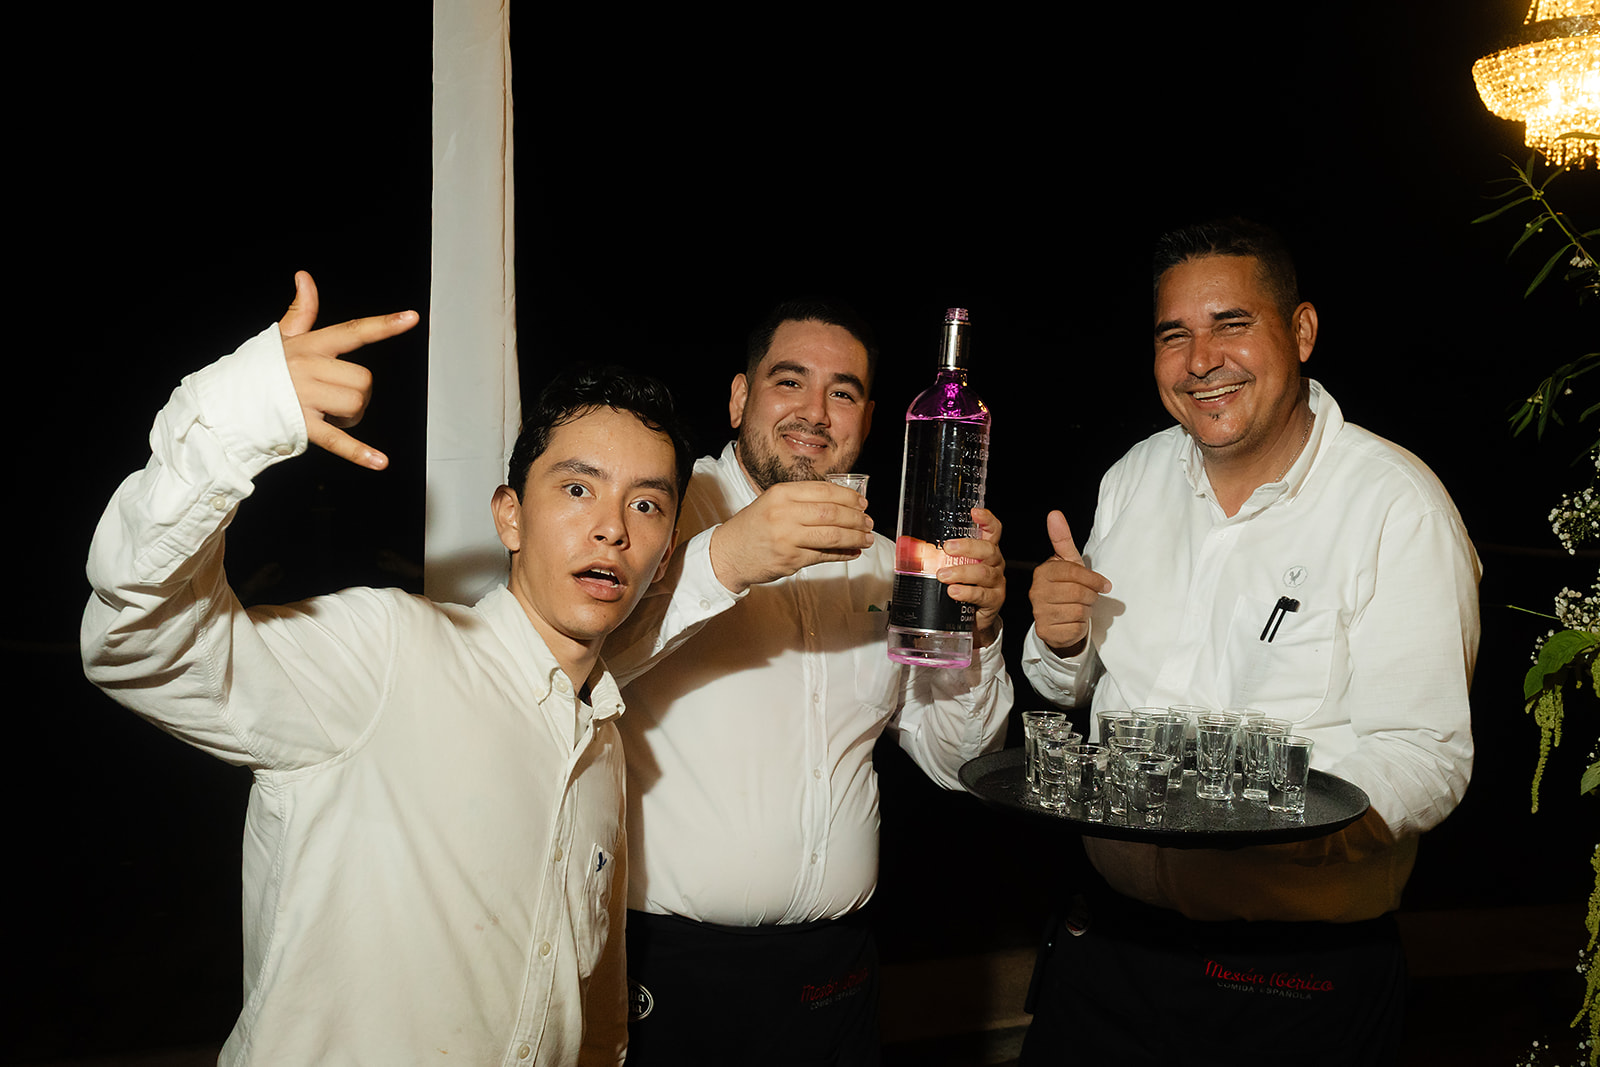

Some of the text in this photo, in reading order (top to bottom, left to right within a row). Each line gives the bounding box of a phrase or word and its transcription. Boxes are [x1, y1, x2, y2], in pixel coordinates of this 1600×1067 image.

[1204, 958, 1335, 992] Mesón Ibérico
[1217, 982, 1255, 993] COMIDA
